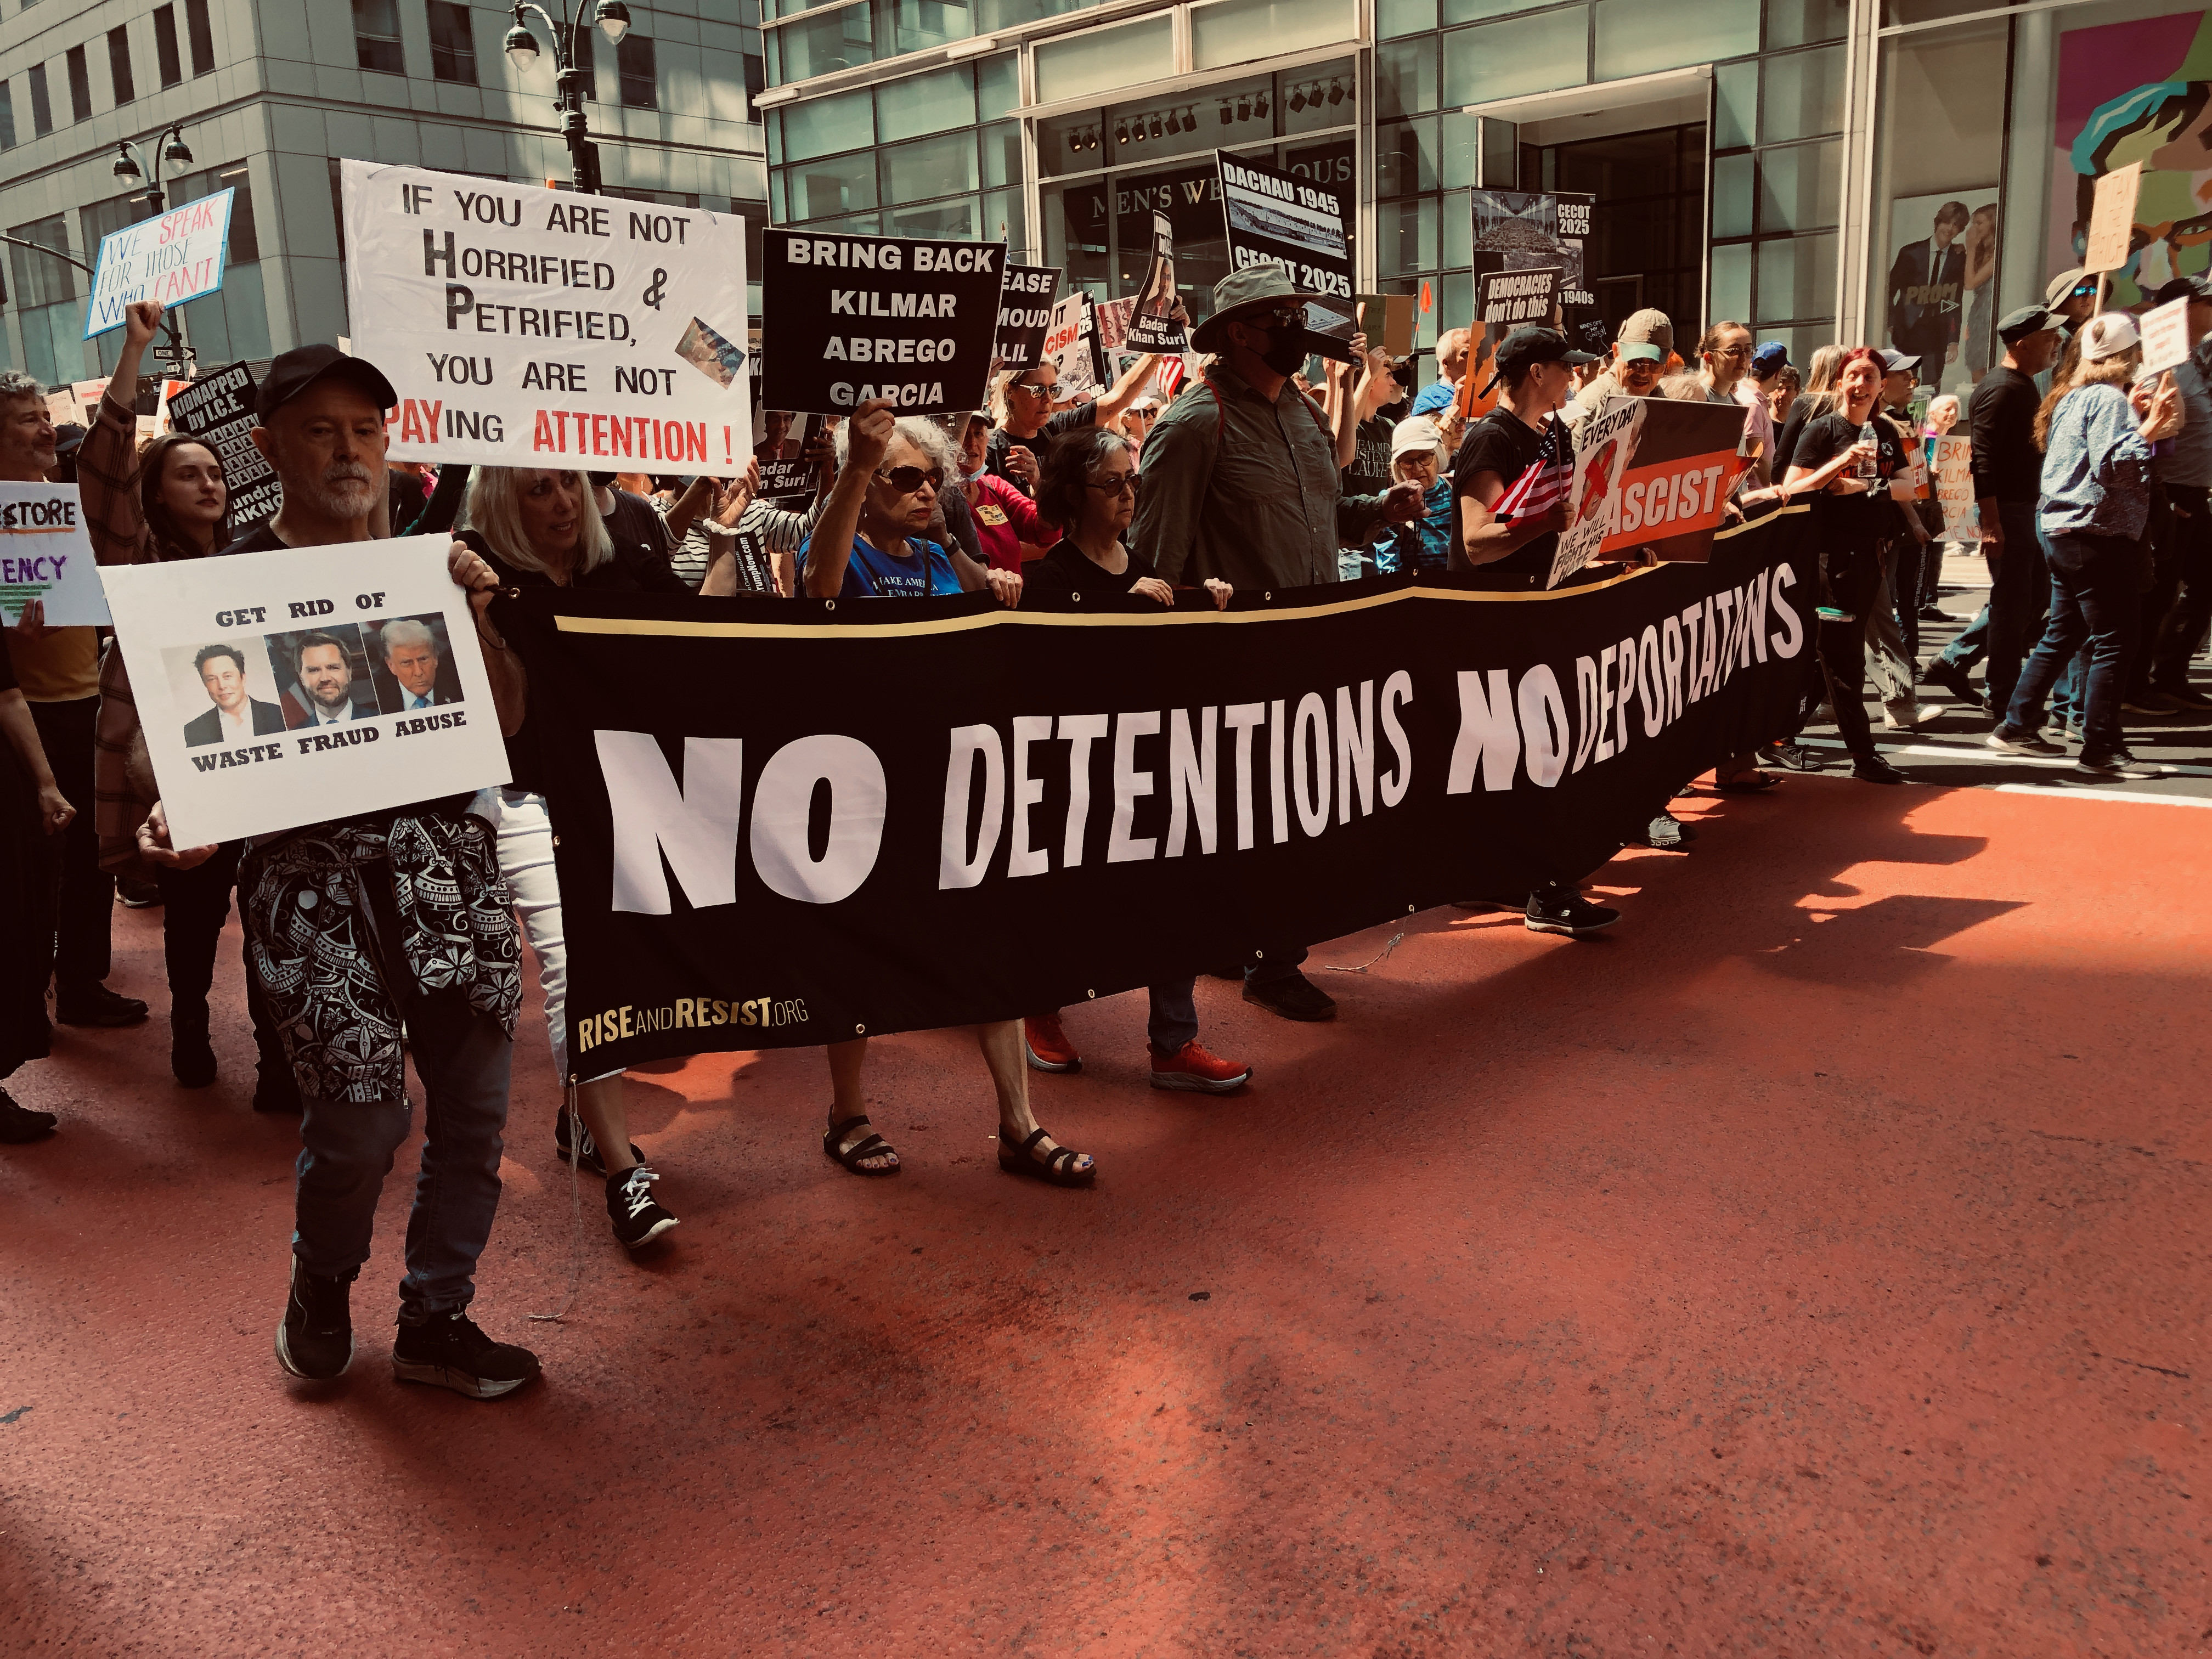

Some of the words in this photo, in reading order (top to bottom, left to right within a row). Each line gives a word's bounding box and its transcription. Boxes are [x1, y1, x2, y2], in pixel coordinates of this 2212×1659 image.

[1223, 161, 1295, 201] DACHAU
[1296, 185, 1340, 215] 1945
[402, 183, 433, 215] IF
[453, 190, 522, 227] YOU
[546, 203, 611, 238] ARE
[629, 212, 691, 245] NOT
[1558, 204, 1591, 219] CECOT
[110, 227, 146, 265] WE
[159, 198, 218, 245] SPEAK
[1559, 218, 1590, 235] 2025
[99, 261, 132, 297] FOR
[145, 236, 193, 278] THOSE
[422, 229, 615, 292] HORRIFIED
[642, 267, 668, 311] &
[787, 238, 902, 270] BRING
[913, 246, 996, 273] BACK
[1002, 270, 1053, 293] EASE
[1301, 264, 1351, 298] 2025
[1487, 273, 1553, 300] DEMOCRACIES
[1904, 282, 1958, 306] PROM
[831, 289, 957, 318] KILMAR
[1485, 298, 1513, 323] don't
[1512, 297, 1526, 320] do
[1527, 295, 1549, 318] this
[1563, 290, 1594, 305] 1940s
[445, 282, 636, 347] PETRIFIED,
[997, 307, 1050, 328] MOUD
[1079, 317, 1093, 337] 25
[1139, 315, 1168, 332] Badar
[823, 336, 956, 363] ABREGO
[1045, 322, 1079, 355] CISM
[1128, 328, 1154, 345] Khan
[1158, 332, 1185, 345] Suri
[426, 352, 494, 386] YOU
[521, 361, 588, 393] ARE
[614, 365, 677, 396] NOT
[171, 368, 249, 419] KIDNAPPED
[830, 381, 944, 408] GARCIA
[187, 410, 206, 431] by
[204, 393, 245, 422] I.C.E.
[384, 398, 504, 444] PAYING
[533, 409, 708, 464] ATTENTION
[1937, 441, 1972, 462] BRIN
[759, 462, 794, 476] adar
[774, 473, 806, 488] Suri
[1938, 467, 1972, 483] ILMA
[233, 481, 283, 510] undre
[1602, 465, 1725, 538] ASCIST
[1937, 488, 1969, 501] BREGO
[0, 499, 76, 526] STORE
[234, 494, 284, 526] NKNO
[1942, 506, 1966, 518] RCIA
[1561, 532, 1578, 554] WE
[1583, 514, 1606, 539] WILL
[1554, 540, 1587, 574] FIGHT
[1586, 530, 1604, 551] HIS
[1558, 550, 1590, 582] HATE
[0, 555, 67, 583] ENCY
[215, 606, 266, 628] GET
[288, 599, 334, 618] RID
[355, 592, 386, 611] OF
[191, 742, 283, 772] WASTE
[297, 726, 380, 755] FRAUD
[394, 711, 467, 737] ABUSE
[1446, 663, 1570, 795] NO
[593, 730, 887, 915] NO
[939, 669, 1414, 891] DETENTIONS
